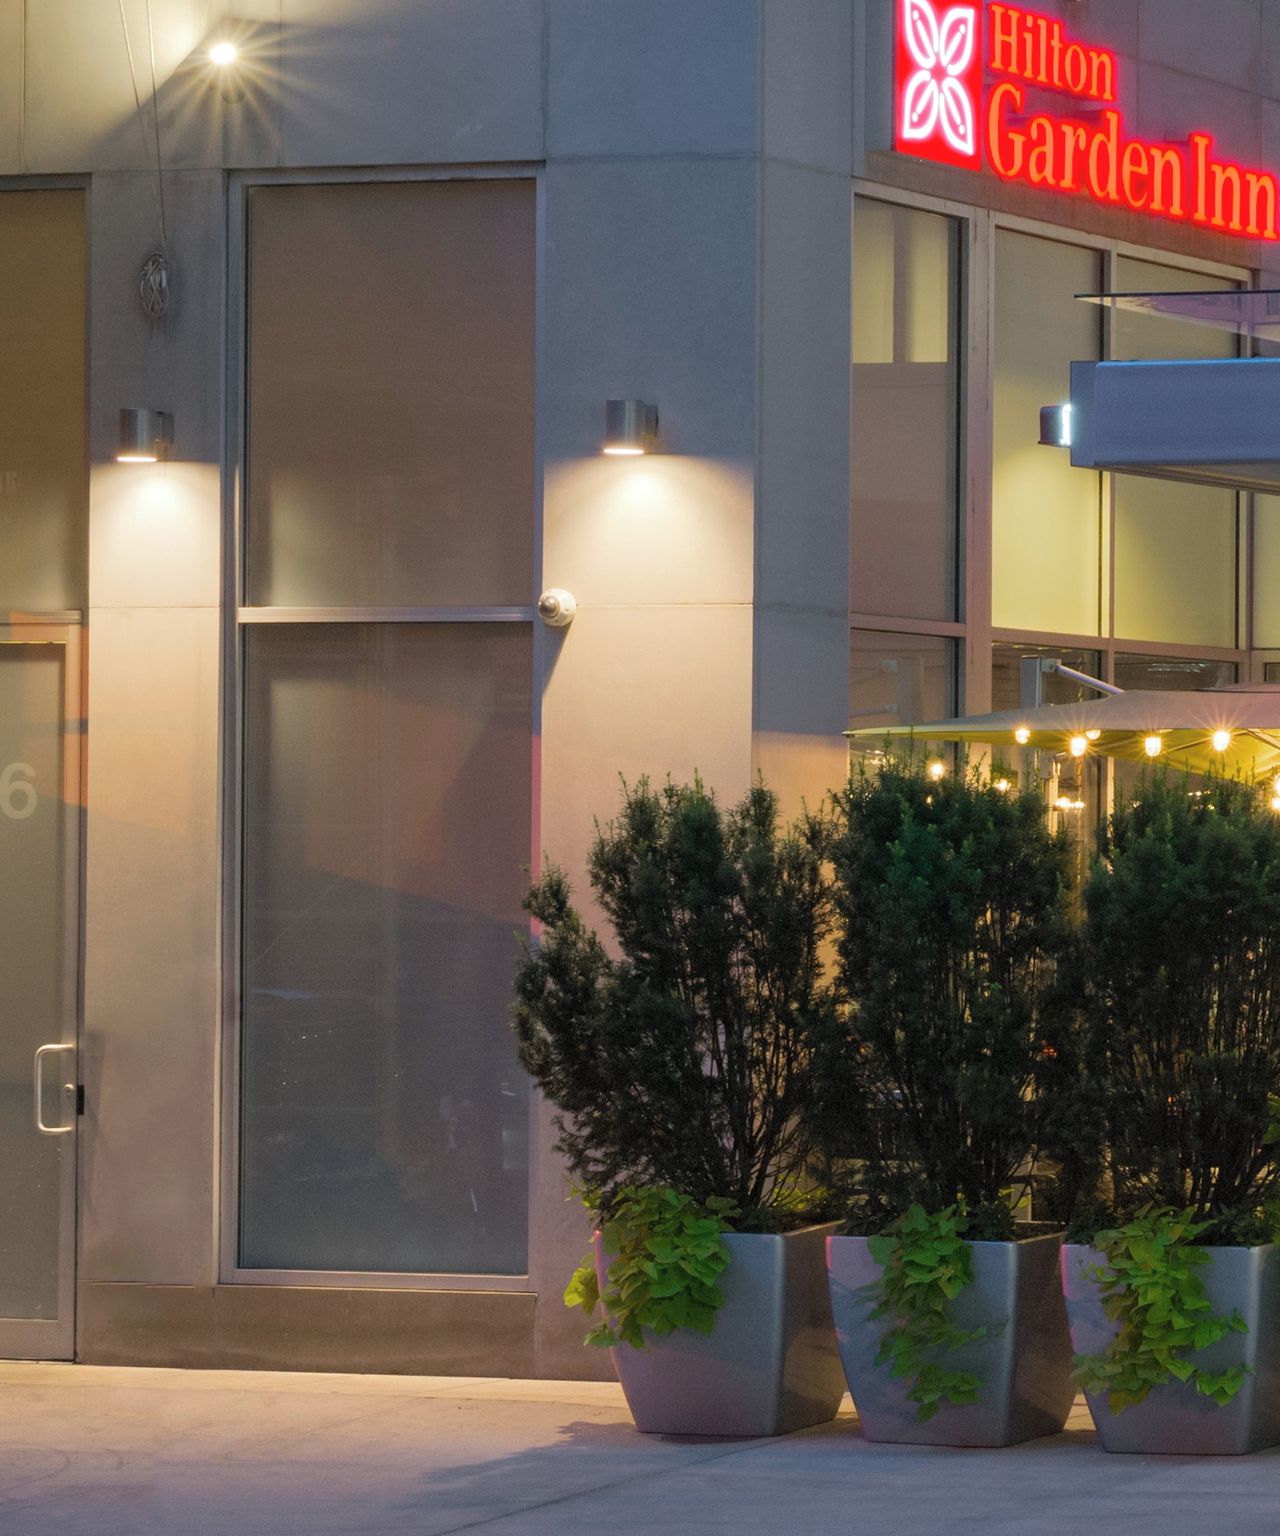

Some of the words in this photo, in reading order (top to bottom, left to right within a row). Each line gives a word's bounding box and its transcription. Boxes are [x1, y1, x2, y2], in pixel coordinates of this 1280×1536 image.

[988, 4, 1114, 101] Hilton
[987, 82, 1184, 217] Garden
[1190, 133, 1279, 240] Inn
